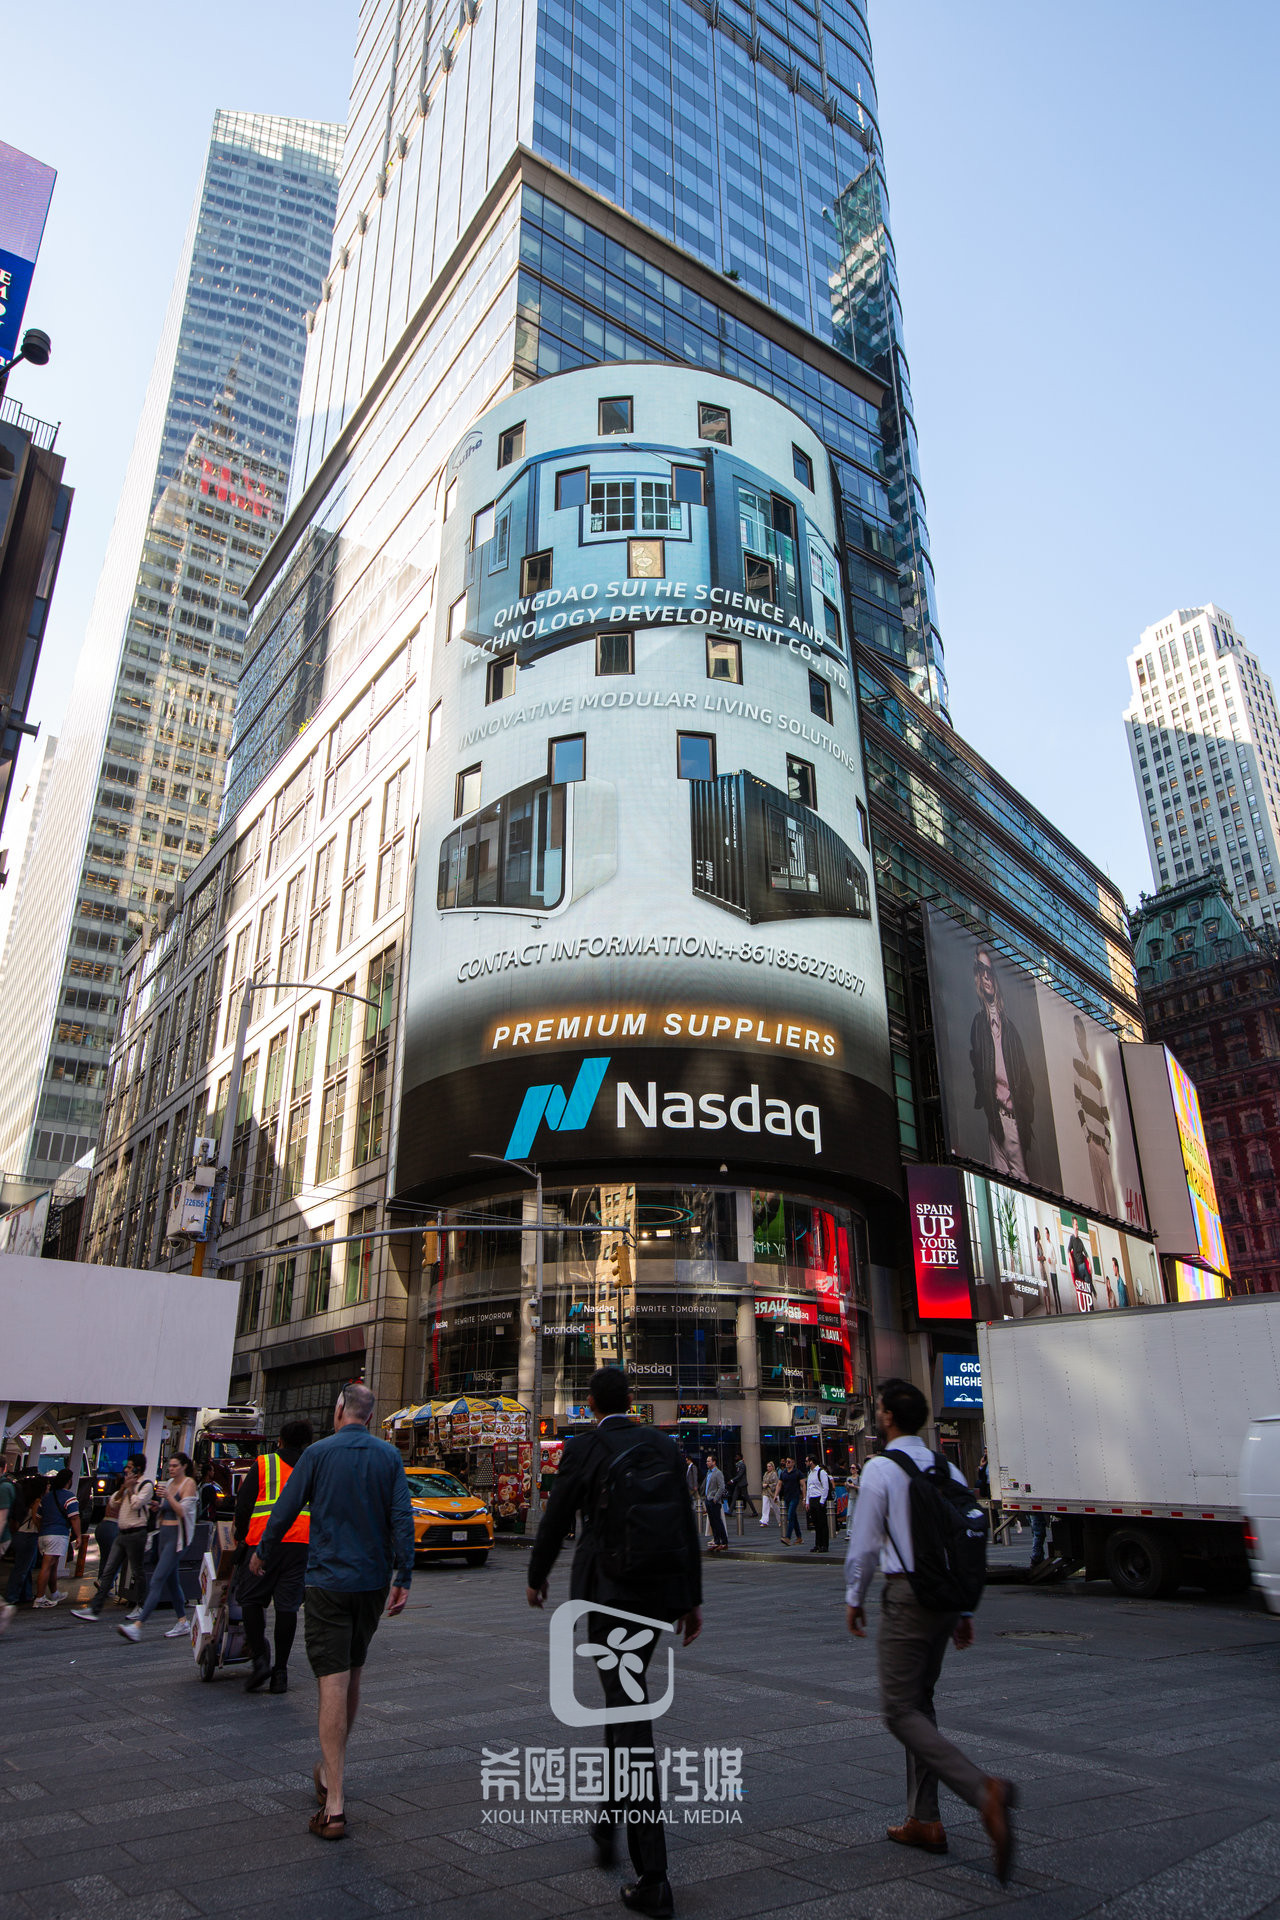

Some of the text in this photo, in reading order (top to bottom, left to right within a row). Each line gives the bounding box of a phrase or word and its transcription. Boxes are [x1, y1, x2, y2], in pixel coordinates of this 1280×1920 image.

[493, 580, 824, 647] QINGDAO SUI HE SCIENCE AND
[463, 604, 850, 695] TECHNOLOGY DEVELOPMENT CO., LTD.
[459, 690, 855, 772] INNOVATIVE MODULAR LIVING SOLUTIONS
[457, 942, 548, 983] CONTACT
[492, 1013, 836, 1057] PREMIUM SUPPLIERS
[616, 1080, 823, 1155] Nasdaq
[916, 1203, 953, 1216] SPAIN
[1125, 1188, 1145, 1228] H&M
[917, 1214, 955, 1238] UP
[919, 1237, 957, 1249] YOUR
[920, 1249, 959, 1265] LIFE
[1075, 1279, 1092, 1293] SPAIN
[583, 1304, 615, 1314] Nasdaq
[630, 1305, 718, 1314] REWRITE TOMORROW
[1077, 1291, 1093, 1313] UP
[628, 1362, 673, 1377] Nasdaq
